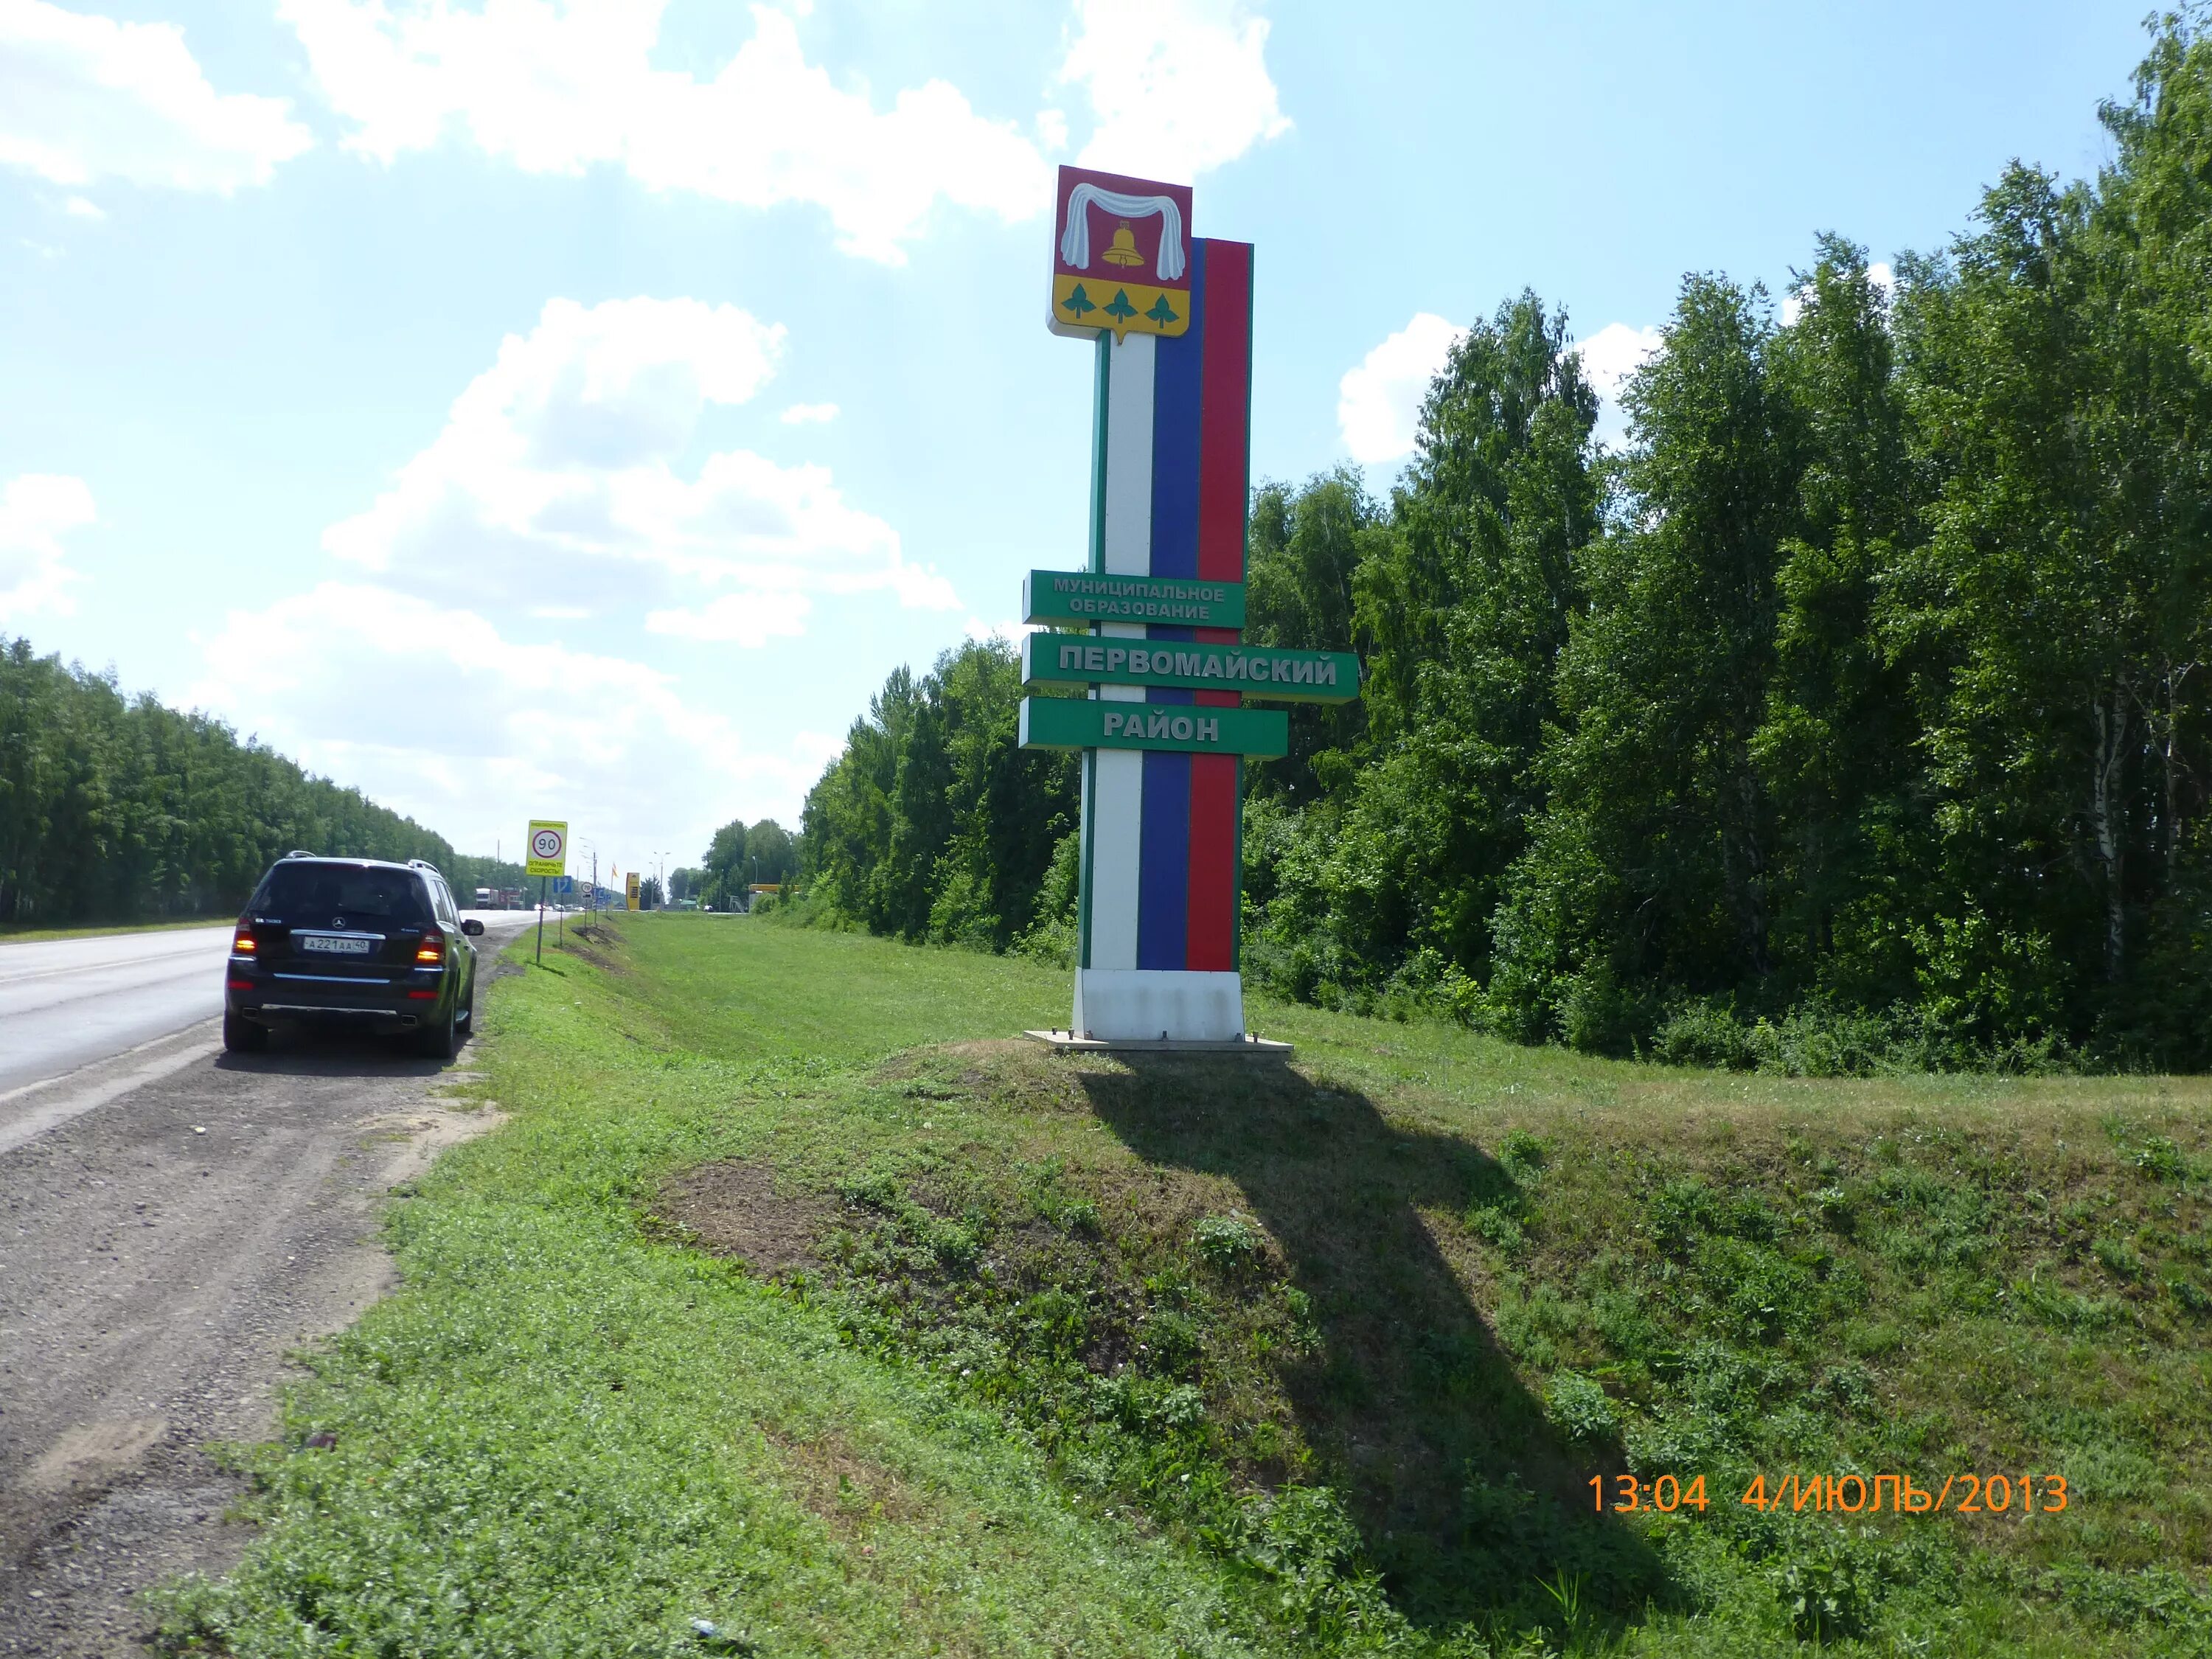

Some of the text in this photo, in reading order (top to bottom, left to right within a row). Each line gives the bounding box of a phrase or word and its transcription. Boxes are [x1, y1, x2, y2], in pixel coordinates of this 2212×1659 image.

[1054, 578, 1225, 603] МУНИЦИПАЛЬНОЕ
[1069, 599, 1209, 620] ОБРАЗОВАНИЕ
[1059, 645, 1337, 686] ПЕРВОМАЙСКИЙ
[1104, 709, 1219, 742] РАЙОН
[538, 838, 556, 850] 90
